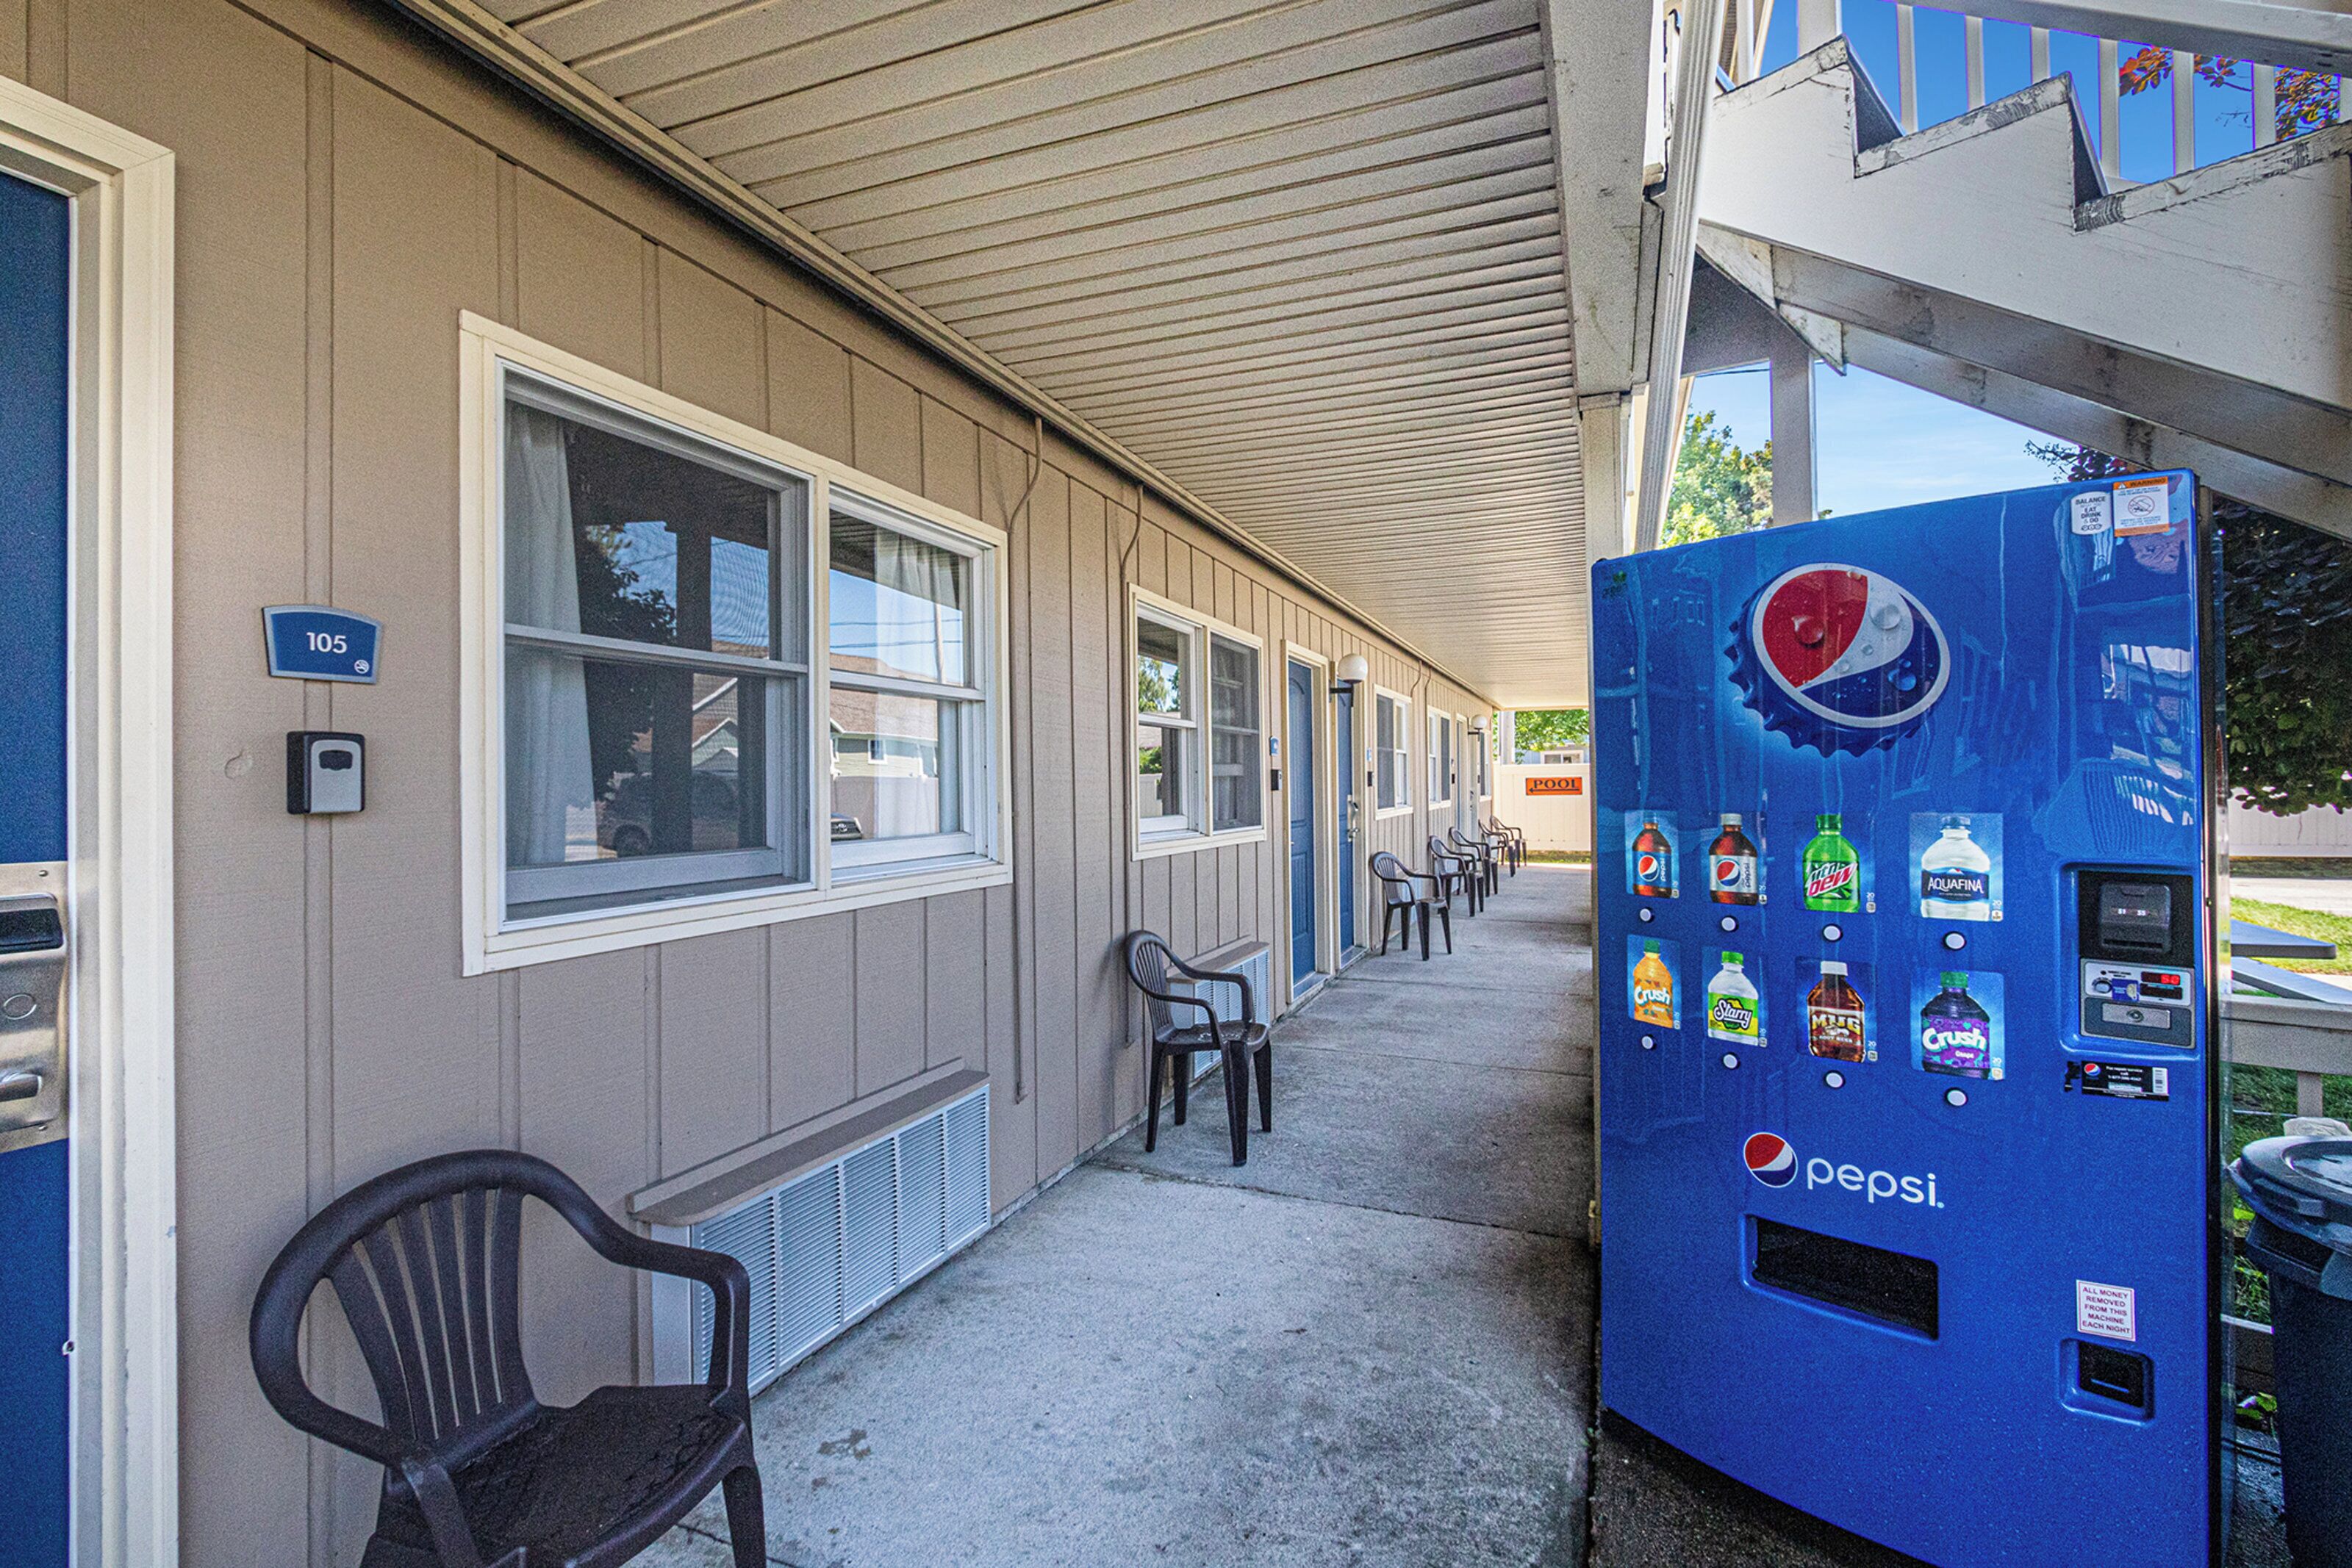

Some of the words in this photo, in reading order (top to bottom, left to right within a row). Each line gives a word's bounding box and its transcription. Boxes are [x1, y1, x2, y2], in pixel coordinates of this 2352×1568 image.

[2130, 478, 2166, 486] WARNING
[2075, 496, 2106, 505] BALANCE
[306, 632, 348, 654] 105
[1534, 779, 1579, 789] POOL
[1743, 863, 1752, 888] pepsi
[1927, 877, 1984, 894] AQUAFINA
[1634, 986, 1670, 1005] Crush
[1714, 999, 1752, 1029] Starry
[1812, 1014, 1860, 1035] MUG
[1922, 1028, 1987, 1051] Crush
[1807, 1157, 1937, 1207] pepsi
[2082, 1287, 2098, 1295] ALL
[2100, 1290, 2128, 1299] MONEY
[2086, 1295, 2126, 1307] REMOVED
[2084, 1303, 2107, 1313] FROM
[2110, 1306, 2128, 1316] THIS
[2087, 1312, 2124, 1325] MACHINE
[2082, 1320, 2104, 1330] EACH
[2106, 1323, 2131, 1334] NIGHT
